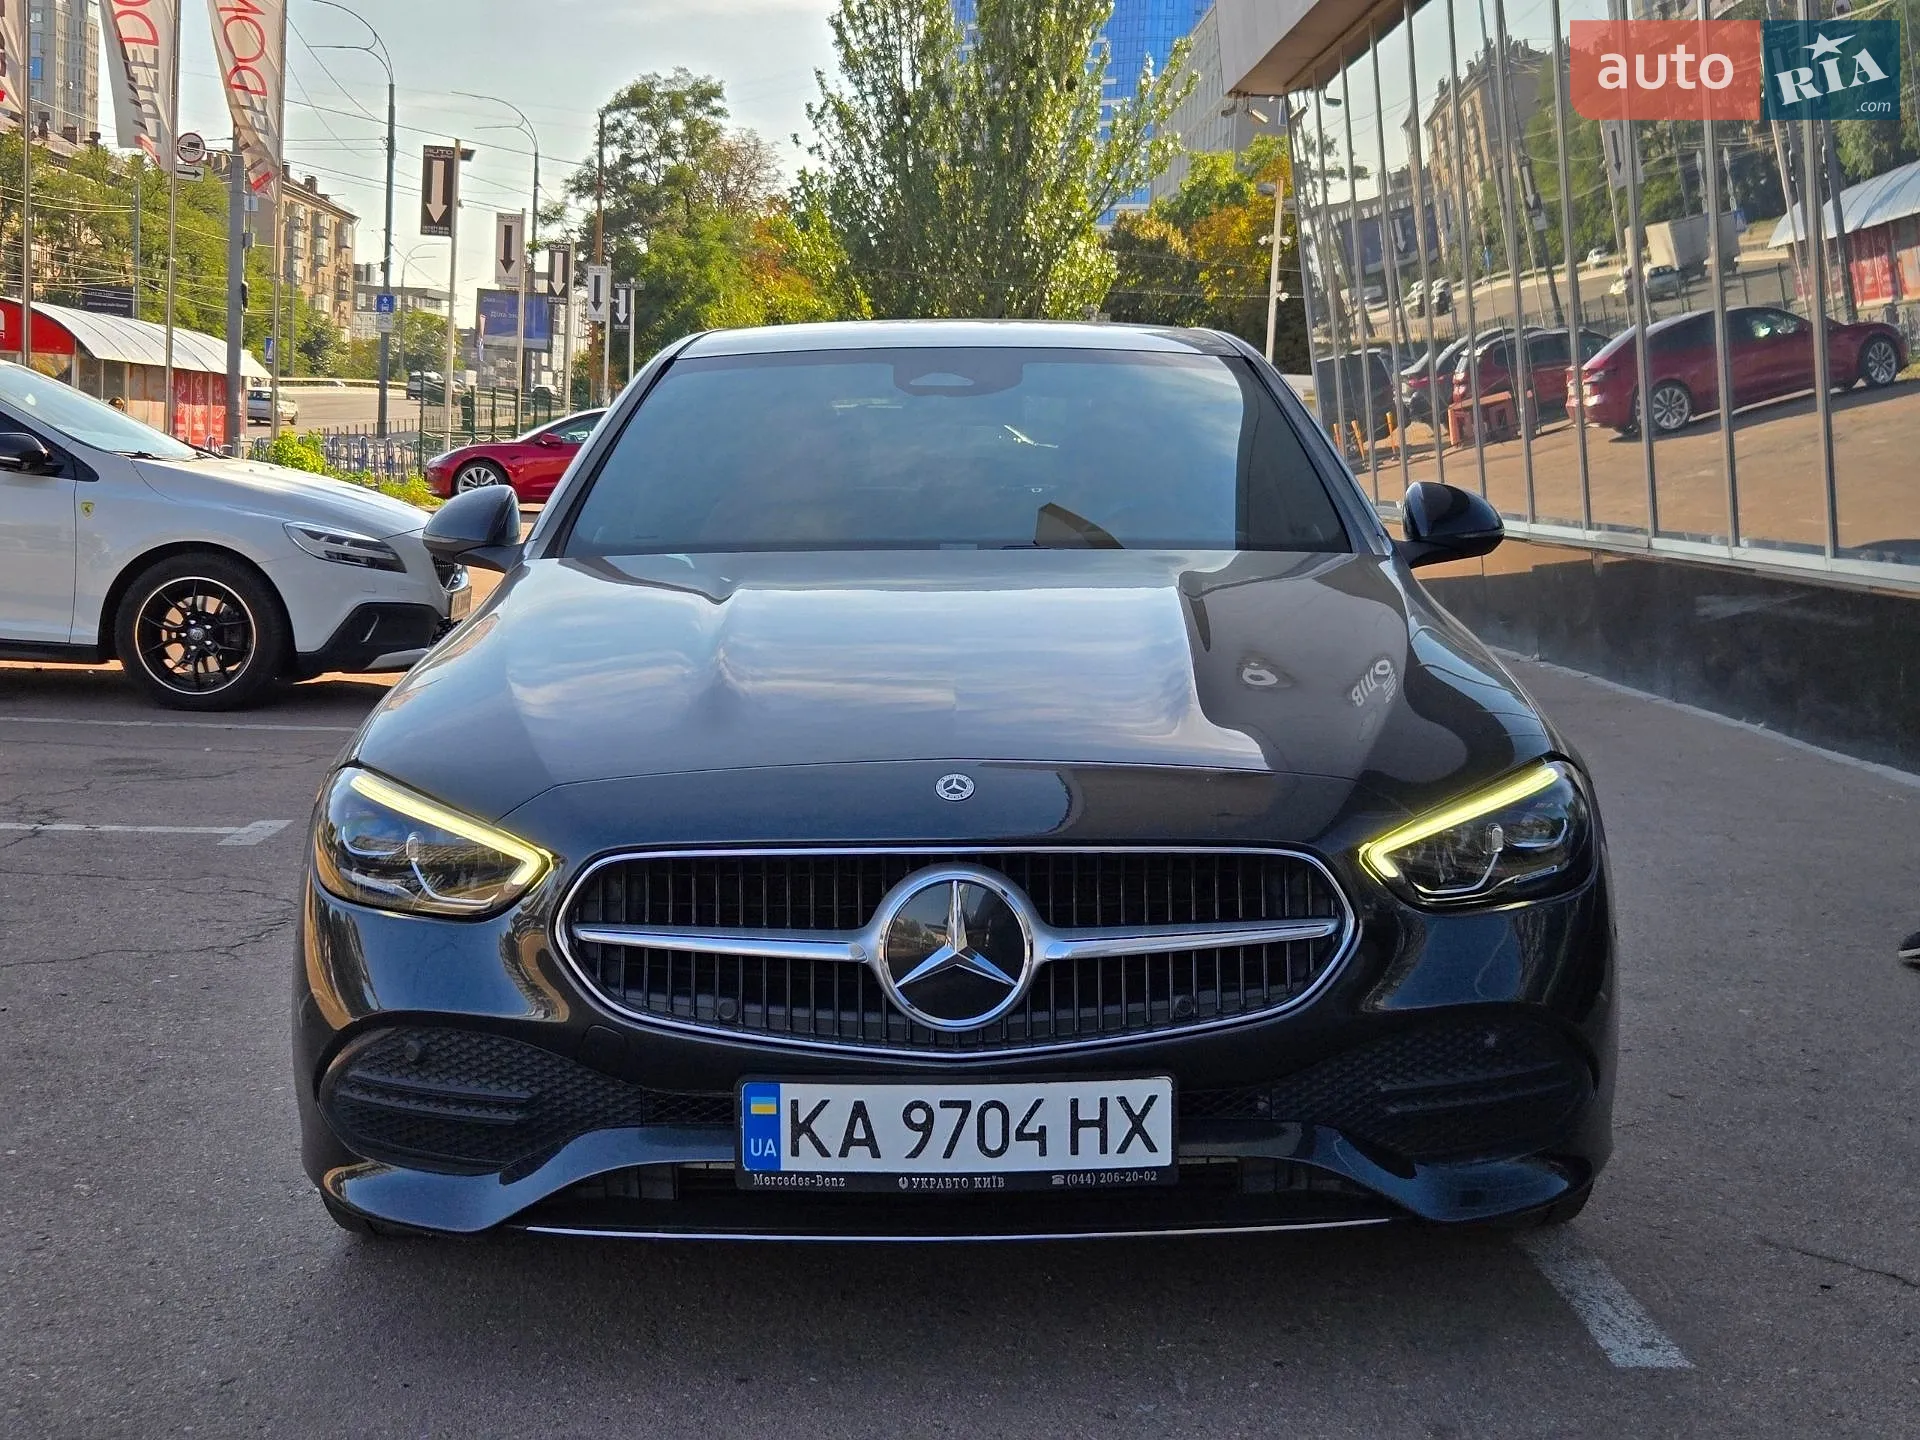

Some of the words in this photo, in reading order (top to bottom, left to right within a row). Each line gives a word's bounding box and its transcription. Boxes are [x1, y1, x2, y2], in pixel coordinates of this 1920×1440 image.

[790, 1099, 881, 1159] KA
[902, 1097, 1048, 1159] 9704
[1070, 1094, 1159, 1156] HX
[750, 1138, 777, 1157] UA
[753, 1174, 846, 1187] Mercedes-Benz
[911, 1178, 969, 1189] УКРАВТО
[974, 1176, 1005, 1189] КИЇВ
[1067, 1173, 1096, 1186] (044)
[1100, 1171, 1158, 1184] 206-20-02
